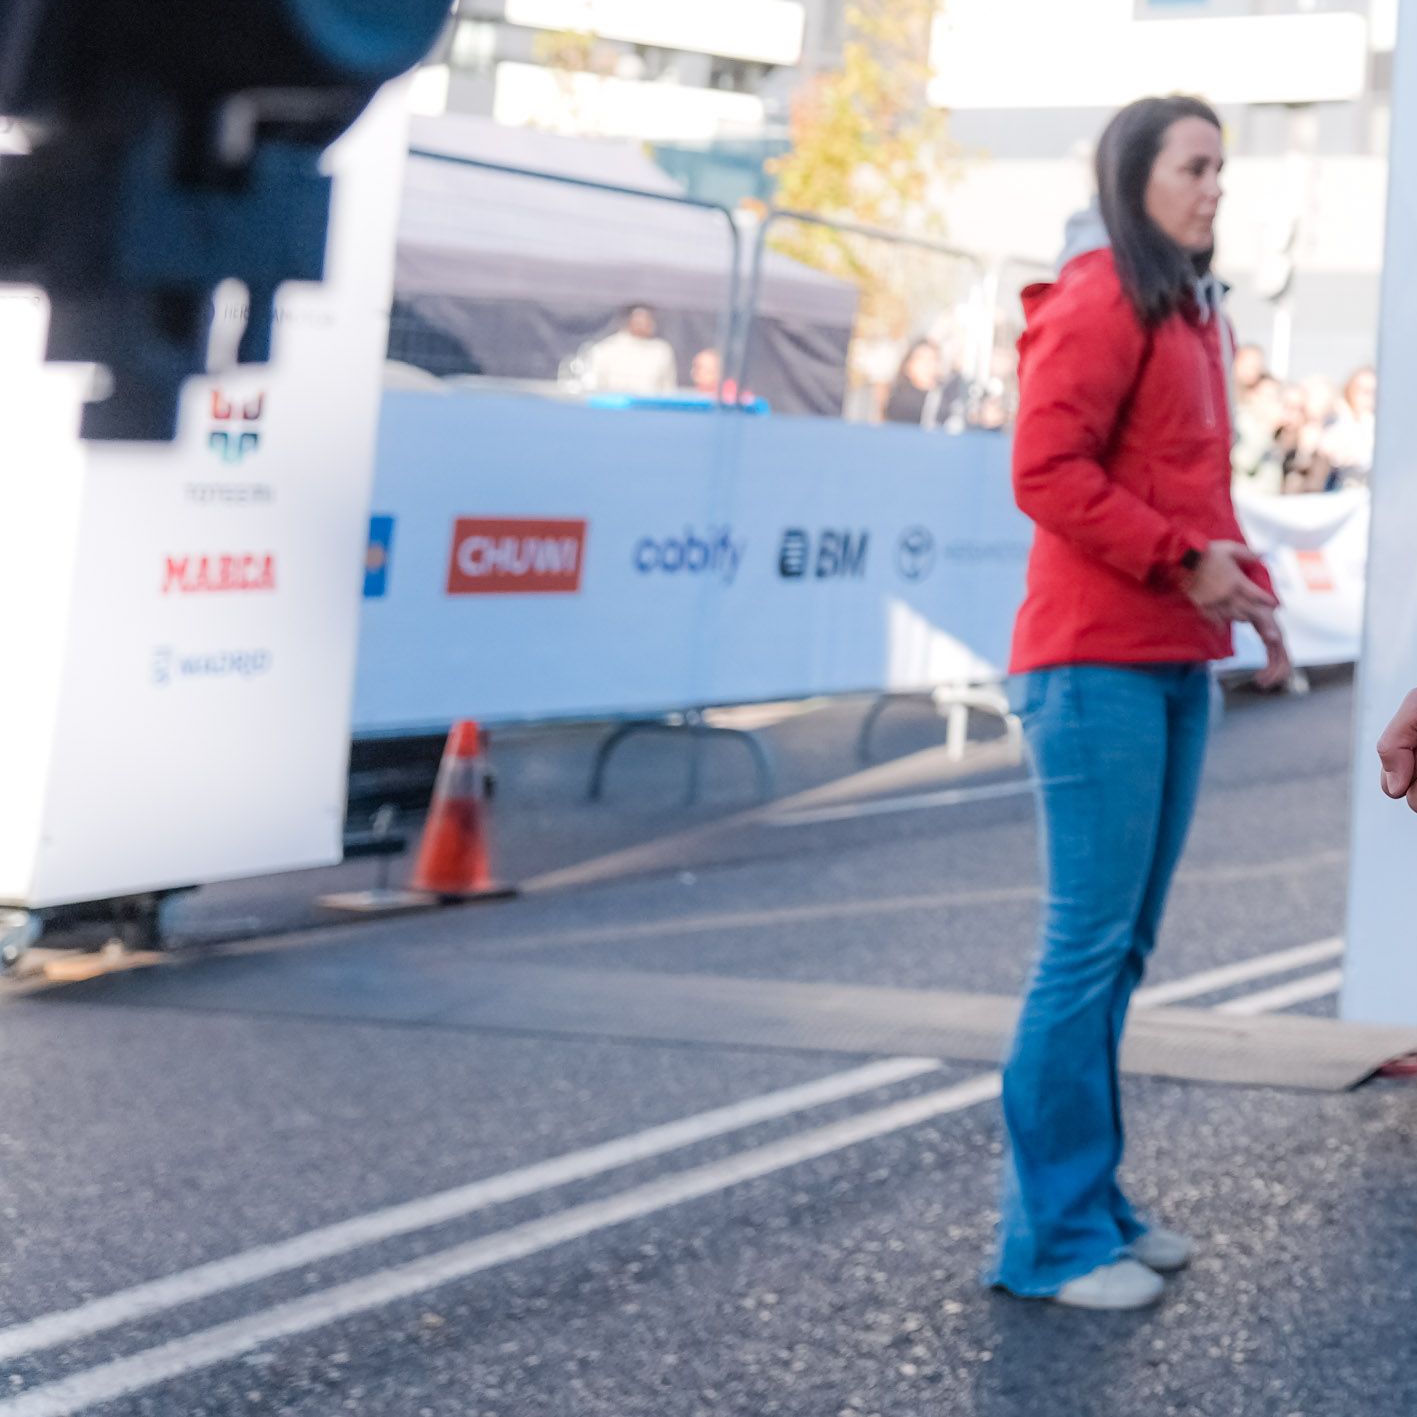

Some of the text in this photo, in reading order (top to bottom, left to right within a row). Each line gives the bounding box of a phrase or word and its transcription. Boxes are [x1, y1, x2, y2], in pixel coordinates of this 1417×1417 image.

[458, 536, 580, 577] CHUWI
[632, 527, 748, 583] cabify
[815, 529, 870, 580] BM
